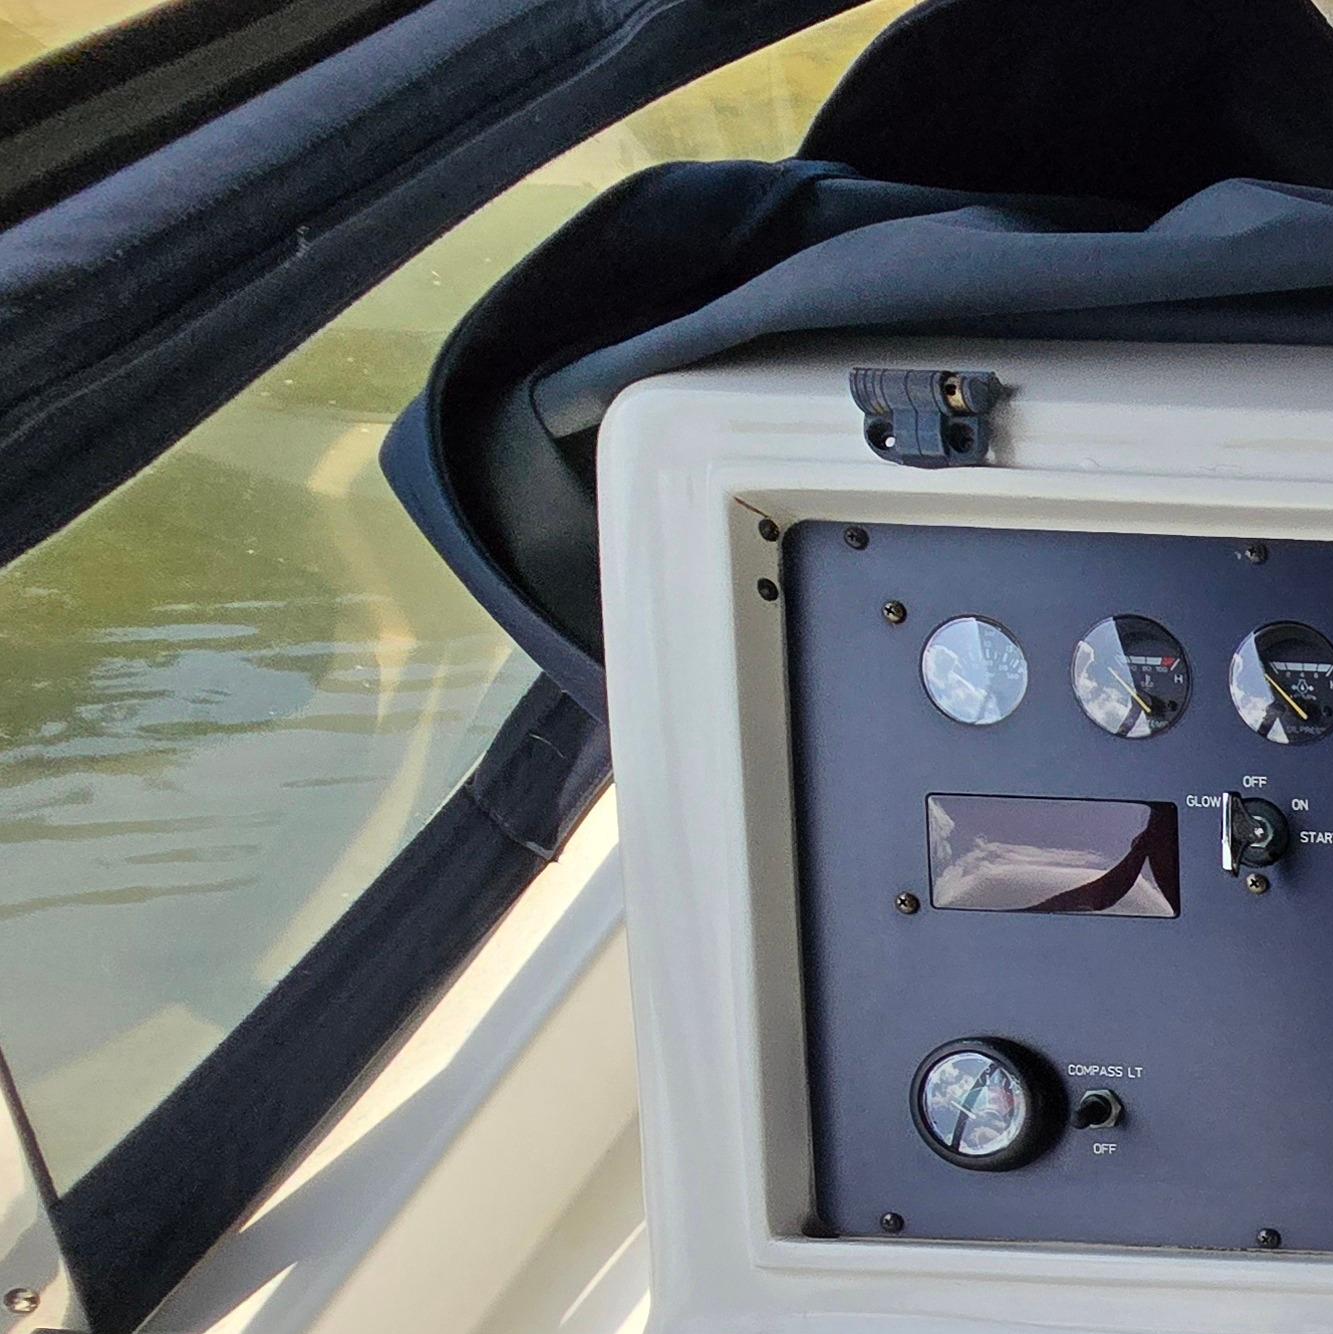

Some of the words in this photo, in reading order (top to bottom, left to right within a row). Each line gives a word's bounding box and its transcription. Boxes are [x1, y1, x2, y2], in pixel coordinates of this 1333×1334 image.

[1174, 674, 1183, 684] H
[1242, 775, 1268, 788] OFF
[1186, 795, 1222, 808] GLOW
[1291, 799, 1309, 811] ON
[1068, 1064, 1123, 1077] COMPASS
[1127, 1067, 1143, 1078] LT
[1093, 1143, 1117, 1155] OFF
